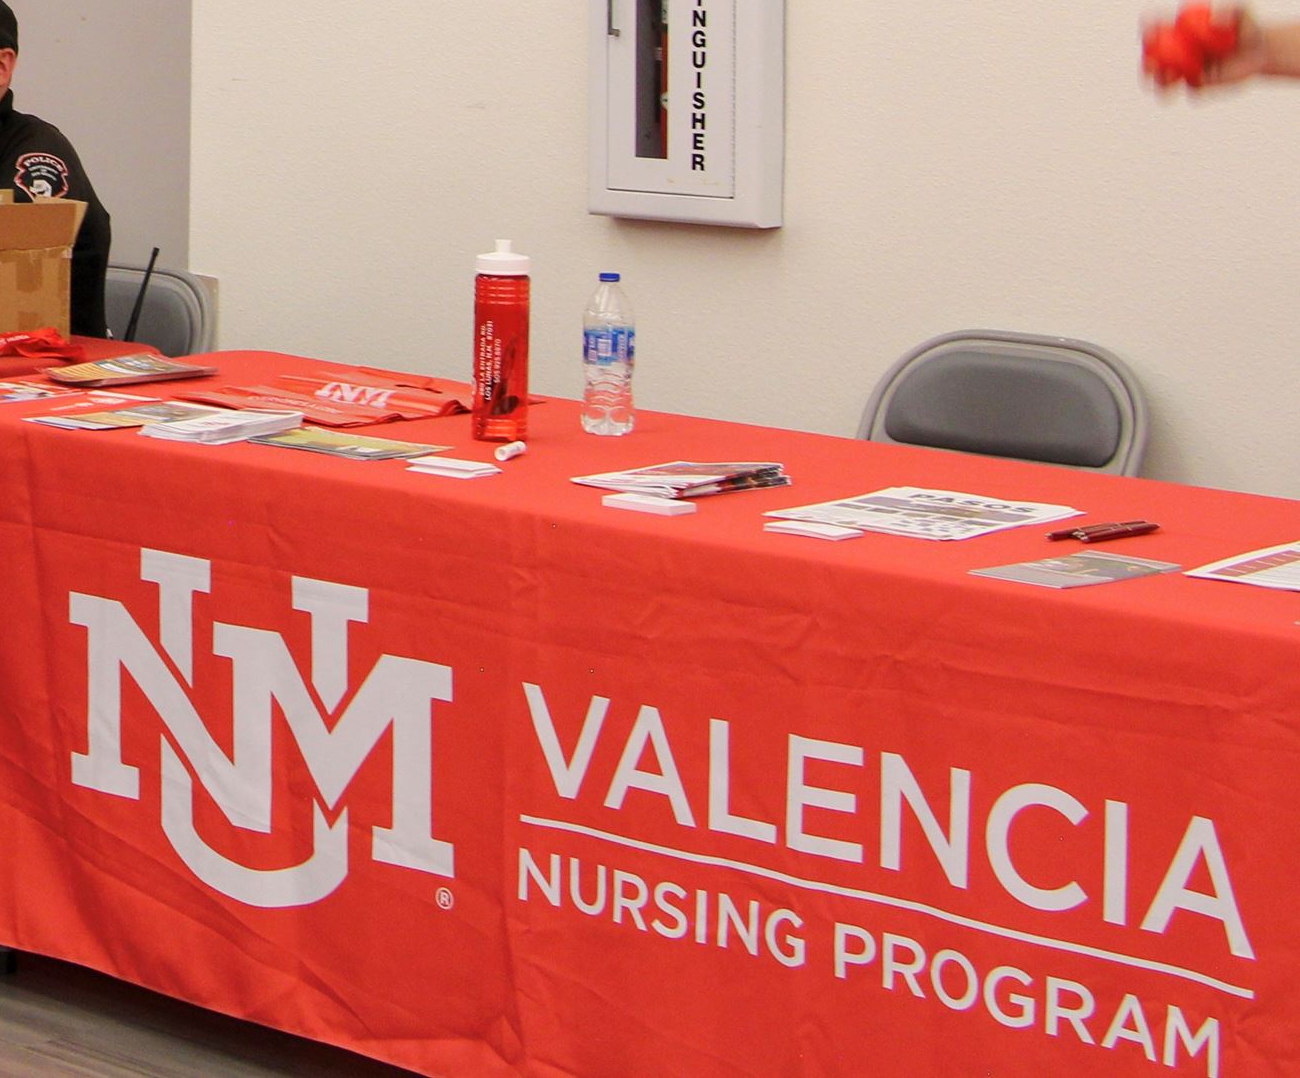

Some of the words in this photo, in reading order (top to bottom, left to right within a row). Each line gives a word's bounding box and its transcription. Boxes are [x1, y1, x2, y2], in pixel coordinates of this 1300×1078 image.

[907, 493, 1037, 514] PASOS
[521, 681, 1256, 961] VALENCIA
[516, 847, 806, 968] NURSING
[833, 922, 1219, 1078] PROGRAM
